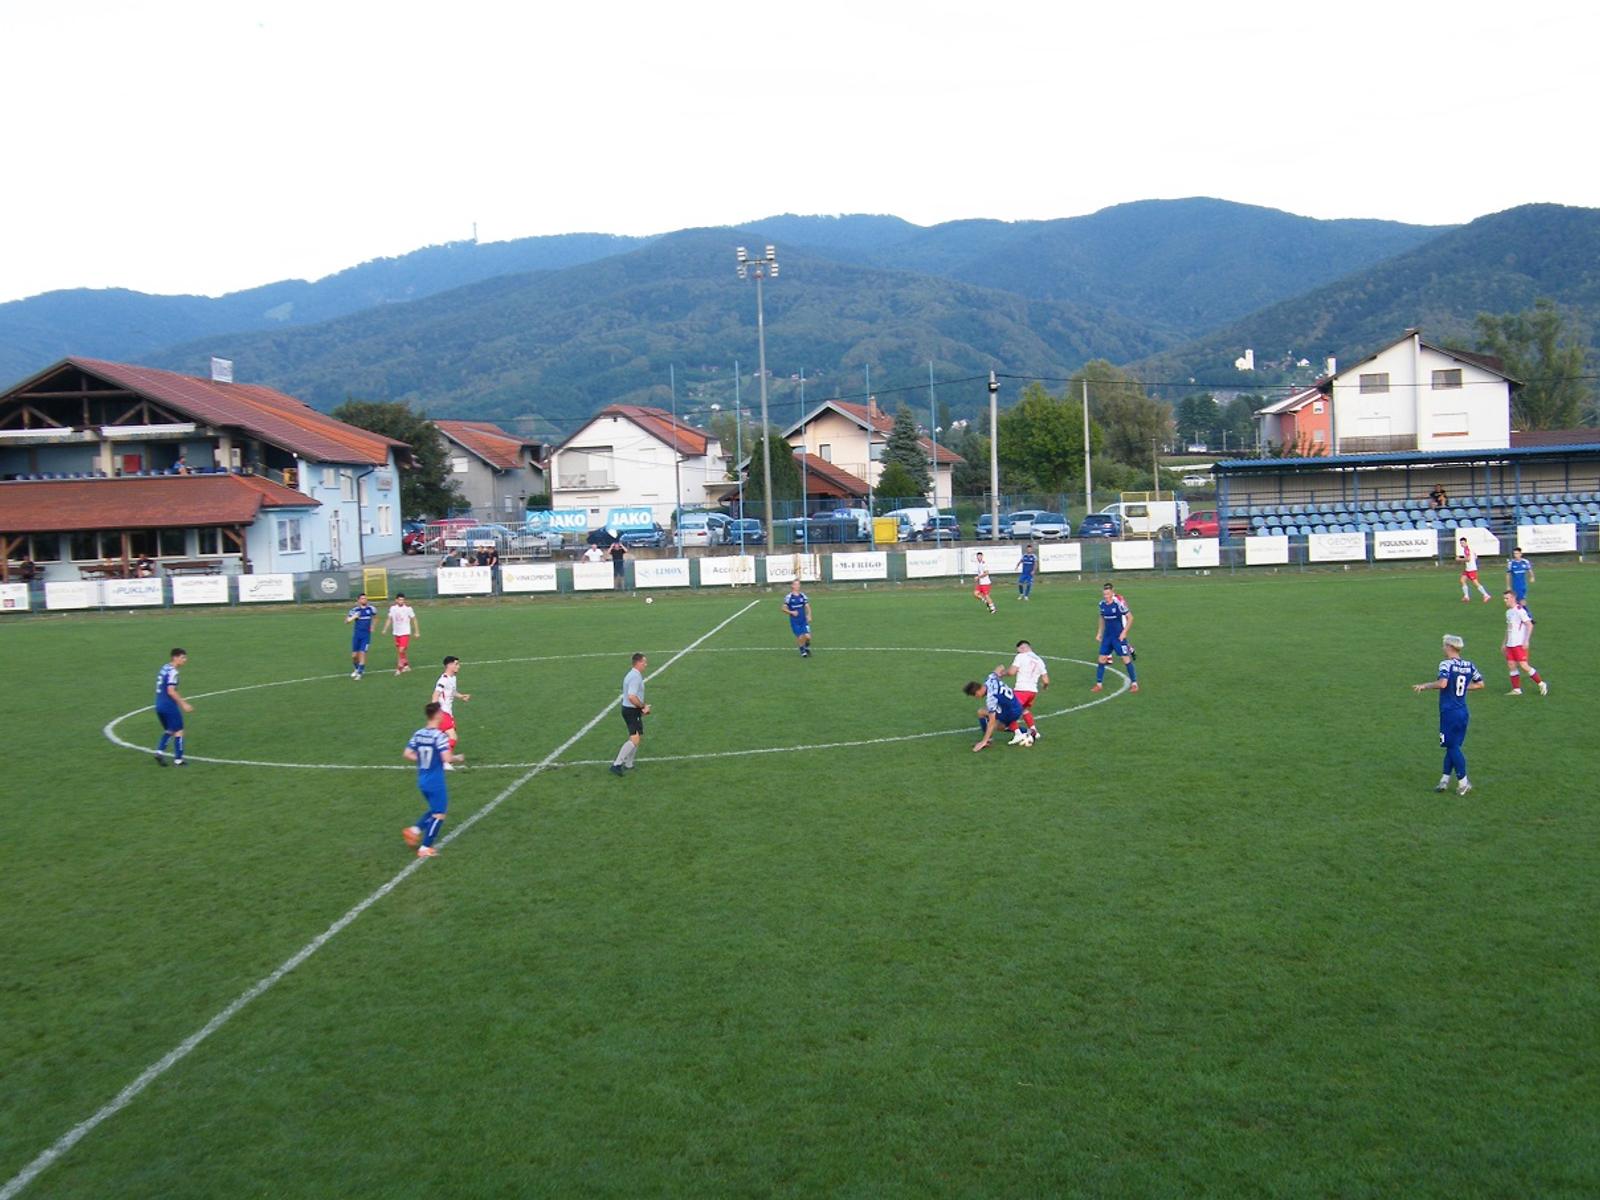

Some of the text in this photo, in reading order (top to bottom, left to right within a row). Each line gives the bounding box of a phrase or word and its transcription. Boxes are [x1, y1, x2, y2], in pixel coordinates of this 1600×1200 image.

[612, 512, 652, 526] JAKO
[1456, 675, 1466, 696] 8
[418, 746, 433, 769] 17
